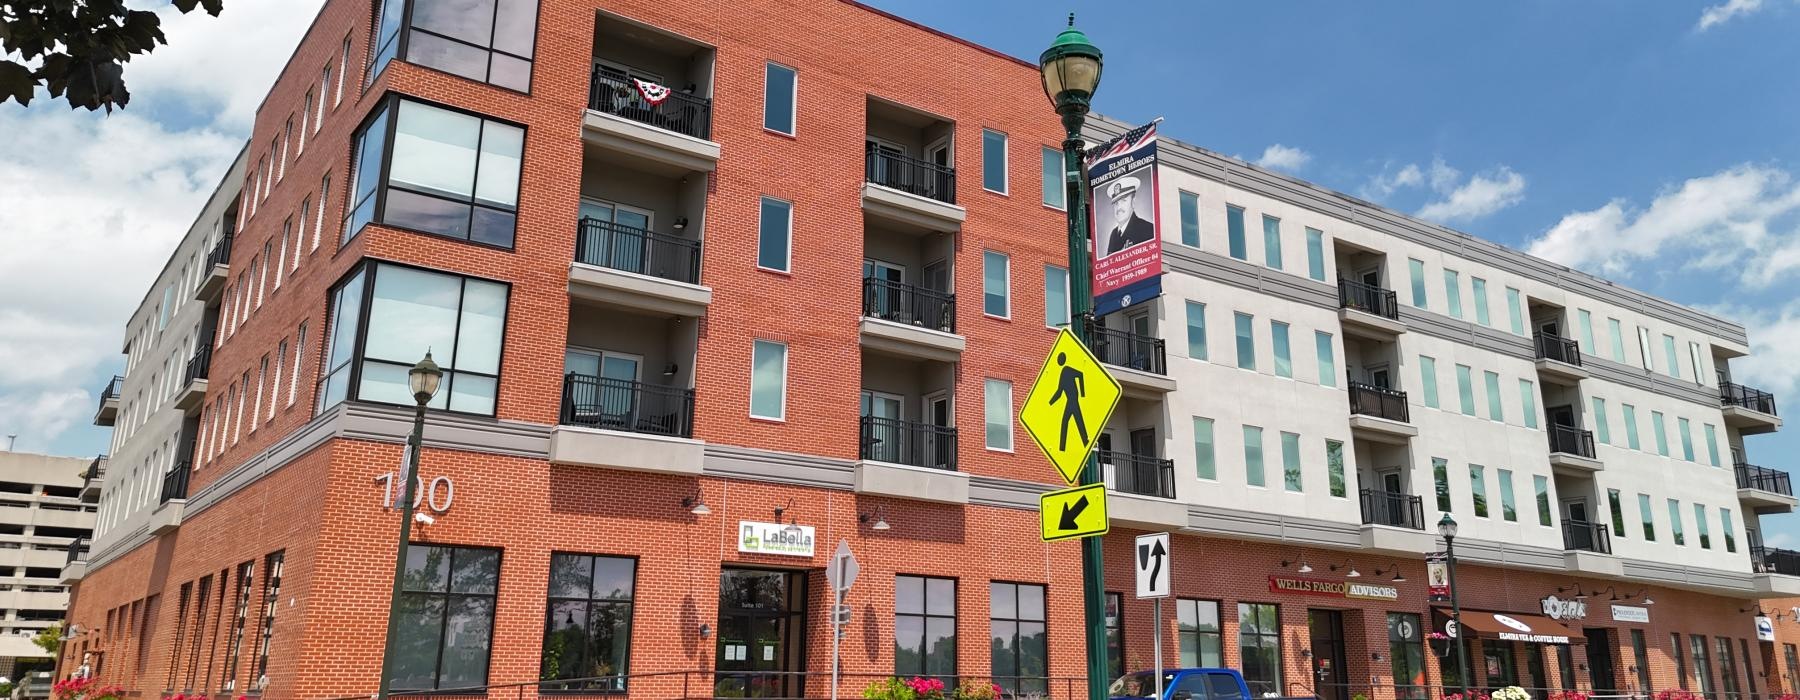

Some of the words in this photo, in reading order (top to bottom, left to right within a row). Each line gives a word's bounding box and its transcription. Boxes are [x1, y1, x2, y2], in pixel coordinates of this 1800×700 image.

[1090, 166, 1127, 187] HOMETOWN
[1128, 154, 1155, 170] HEROES
[1108, 155, 1134, 171] ELMIRA
[1095, 271, 1110, 281] Chief
[1109, 263, 1132, 275] Warrant
[1132, 256, 1151, 267] Officer
[1106, 279, 1119, 288] Navy
[763, 528, 811, 546] LaBella
[1276, 578, 1311, 591] WELLS
[1313, 580, 1344, 593] FARGO
[1349, 584, 1398, 598] ADVISORS
[1499, 632, 1519, 640] ELMIRA
